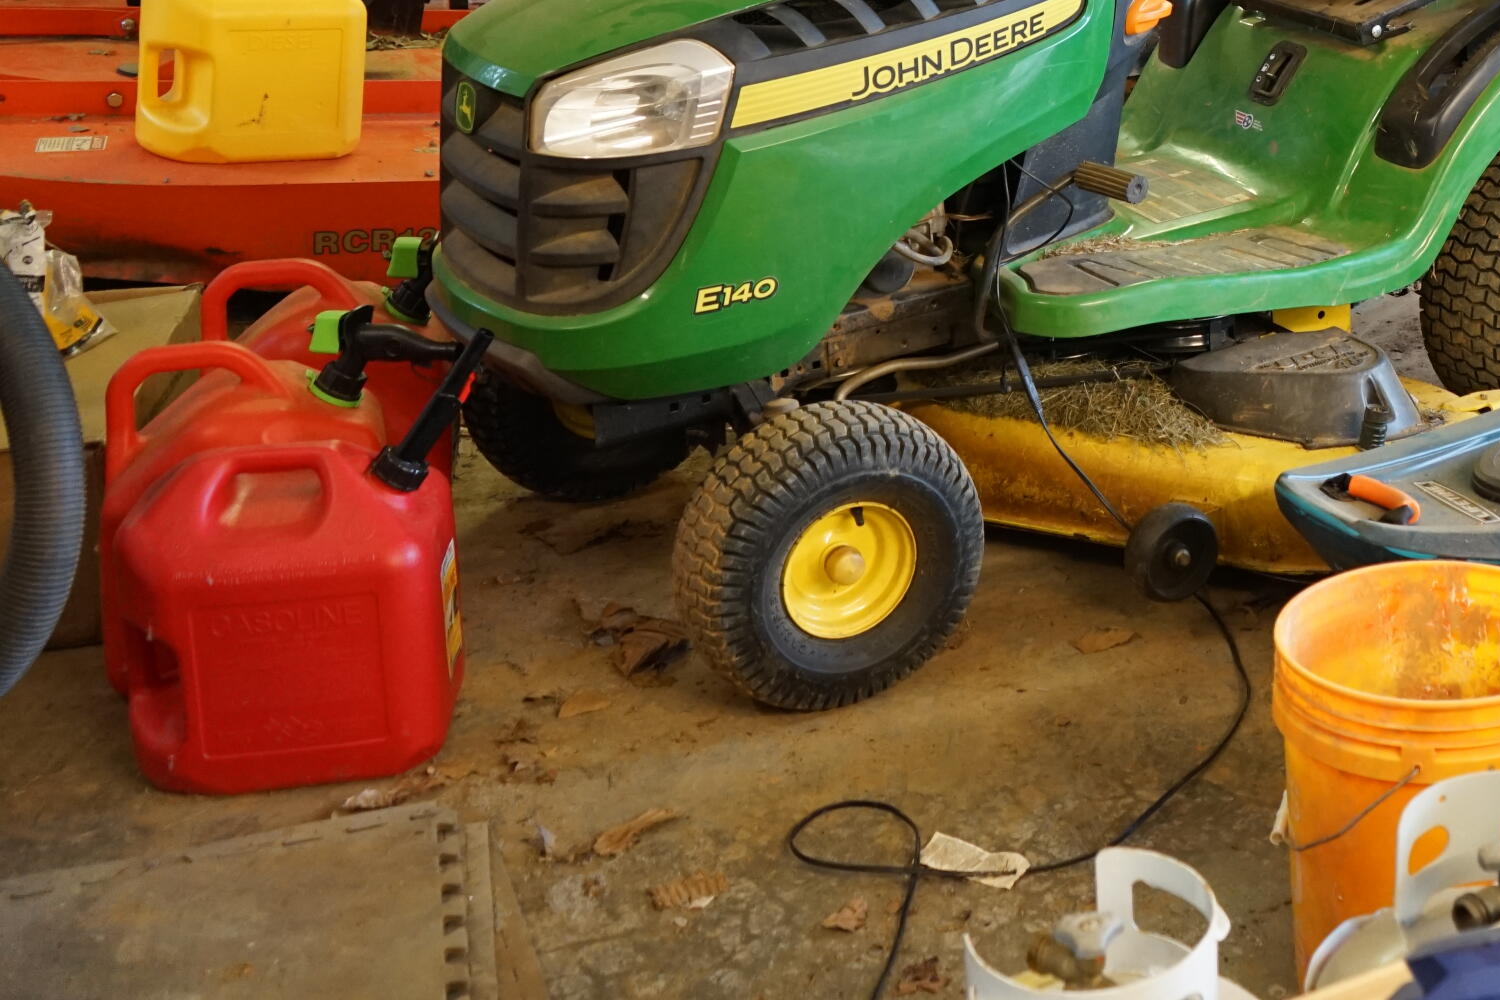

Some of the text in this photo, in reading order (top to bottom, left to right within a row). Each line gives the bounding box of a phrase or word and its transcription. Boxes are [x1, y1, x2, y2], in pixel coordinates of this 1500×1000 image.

[246, 32, 320, 52] DIESE
[852, 11, 1045, 97] JOHN DEERE
[693, 276, 779, 314] E140
[210, 602, 364, 637] GASOLINE
